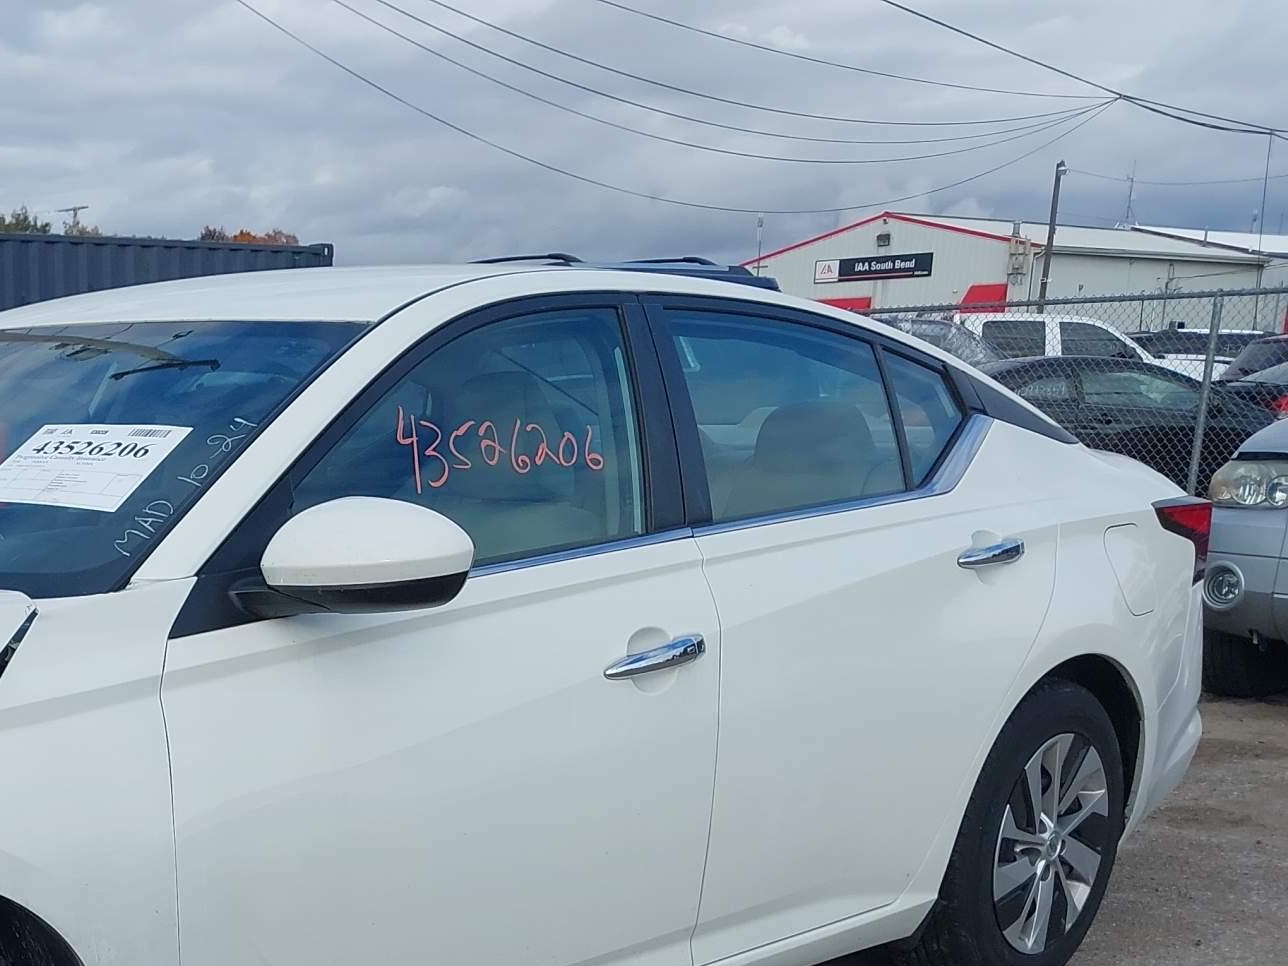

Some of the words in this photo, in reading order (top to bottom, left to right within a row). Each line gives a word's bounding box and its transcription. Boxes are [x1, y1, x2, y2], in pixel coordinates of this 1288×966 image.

[854, 261, 869, 272] IAA
[870, 260, 893, 271] South
[894, 258, 916, 269] Bend
[32, 440, 158, 459] 43526206
[396, 405, 604, 494] 43526206
[113, 500, 174, 557] MAD
